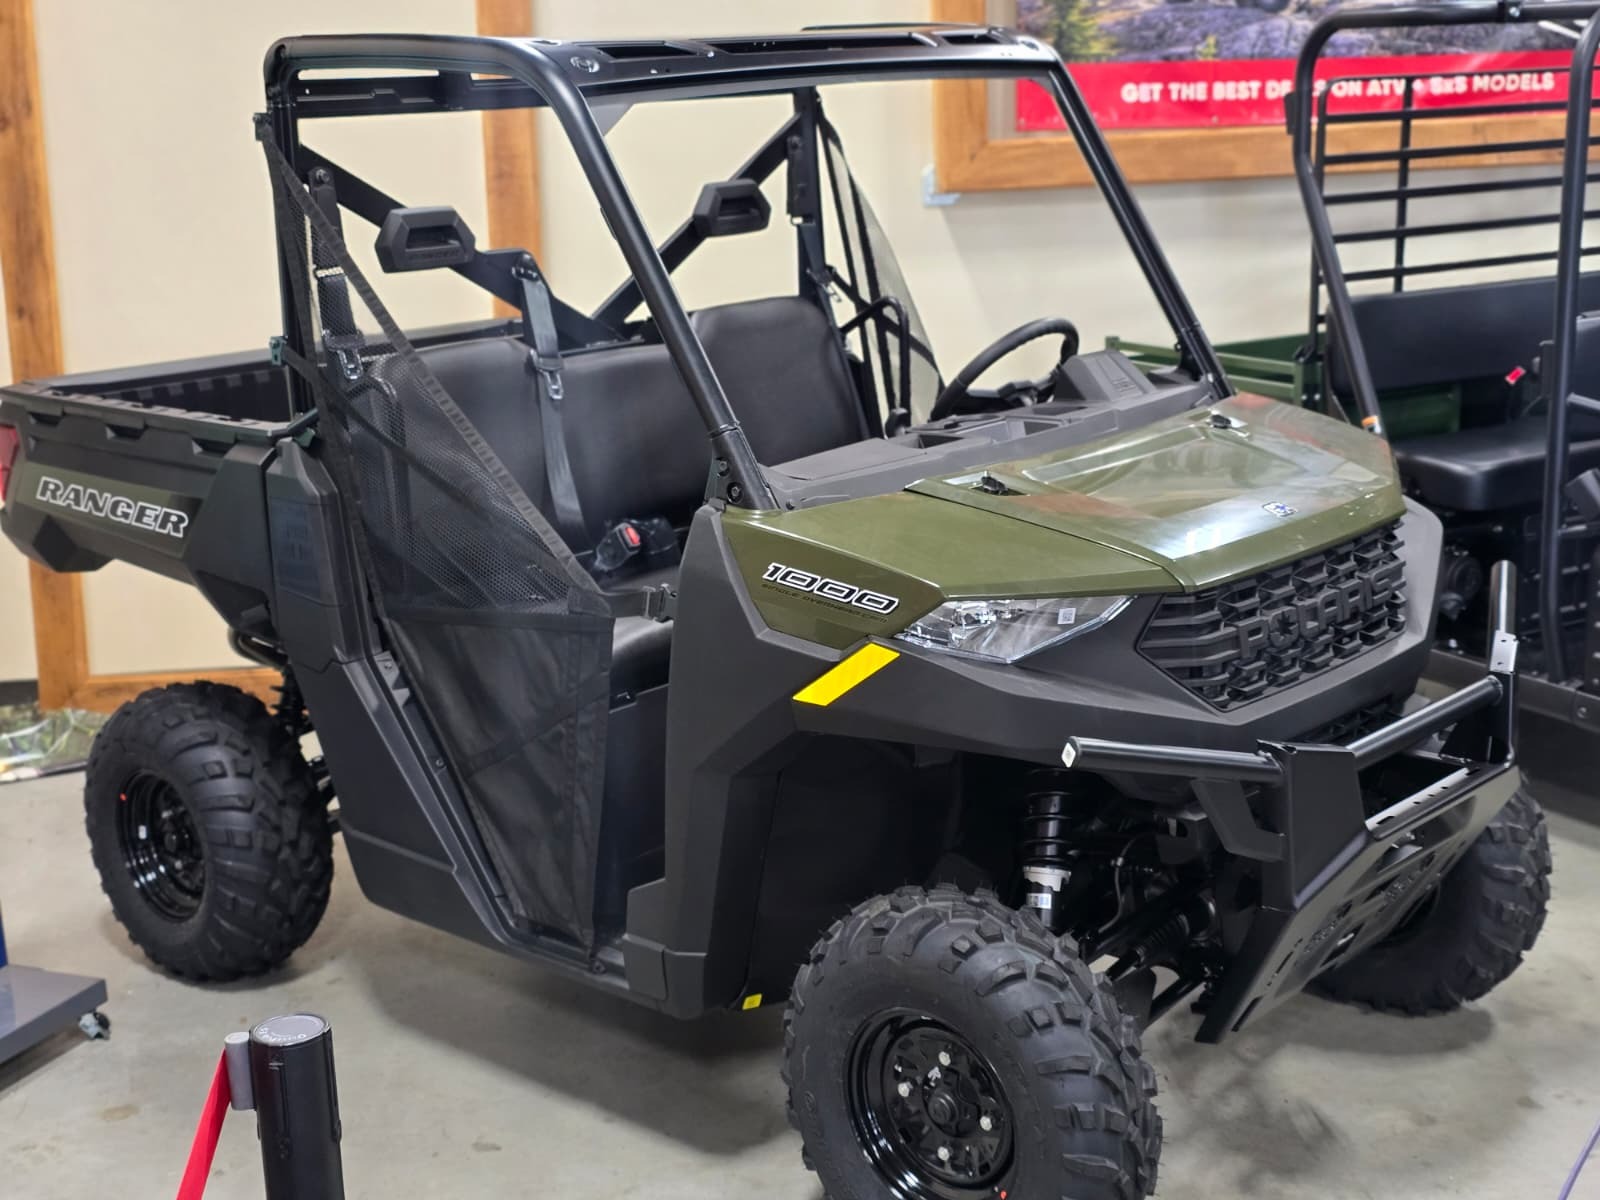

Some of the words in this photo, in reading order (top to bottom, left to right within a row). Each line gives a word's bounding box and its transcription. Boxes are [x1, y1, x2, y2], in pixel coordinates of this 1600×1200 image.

[1120, 82, 1163, 102] GET
[1167, 81, 1208, 101] THE
[1212, 80, 1261, 101] BEST
[1265, 79, 1327, 100] DES
[1331, 78, 1362, 97] ON
[1366, 78, 1406, 97] ATV
[1472, 72, 1555, 93] MODELS
[36, 476, 189, 538] RANGER
[762, 562, 900, 614] 1000
[1237, 561, 1402, 662] POLARIS
